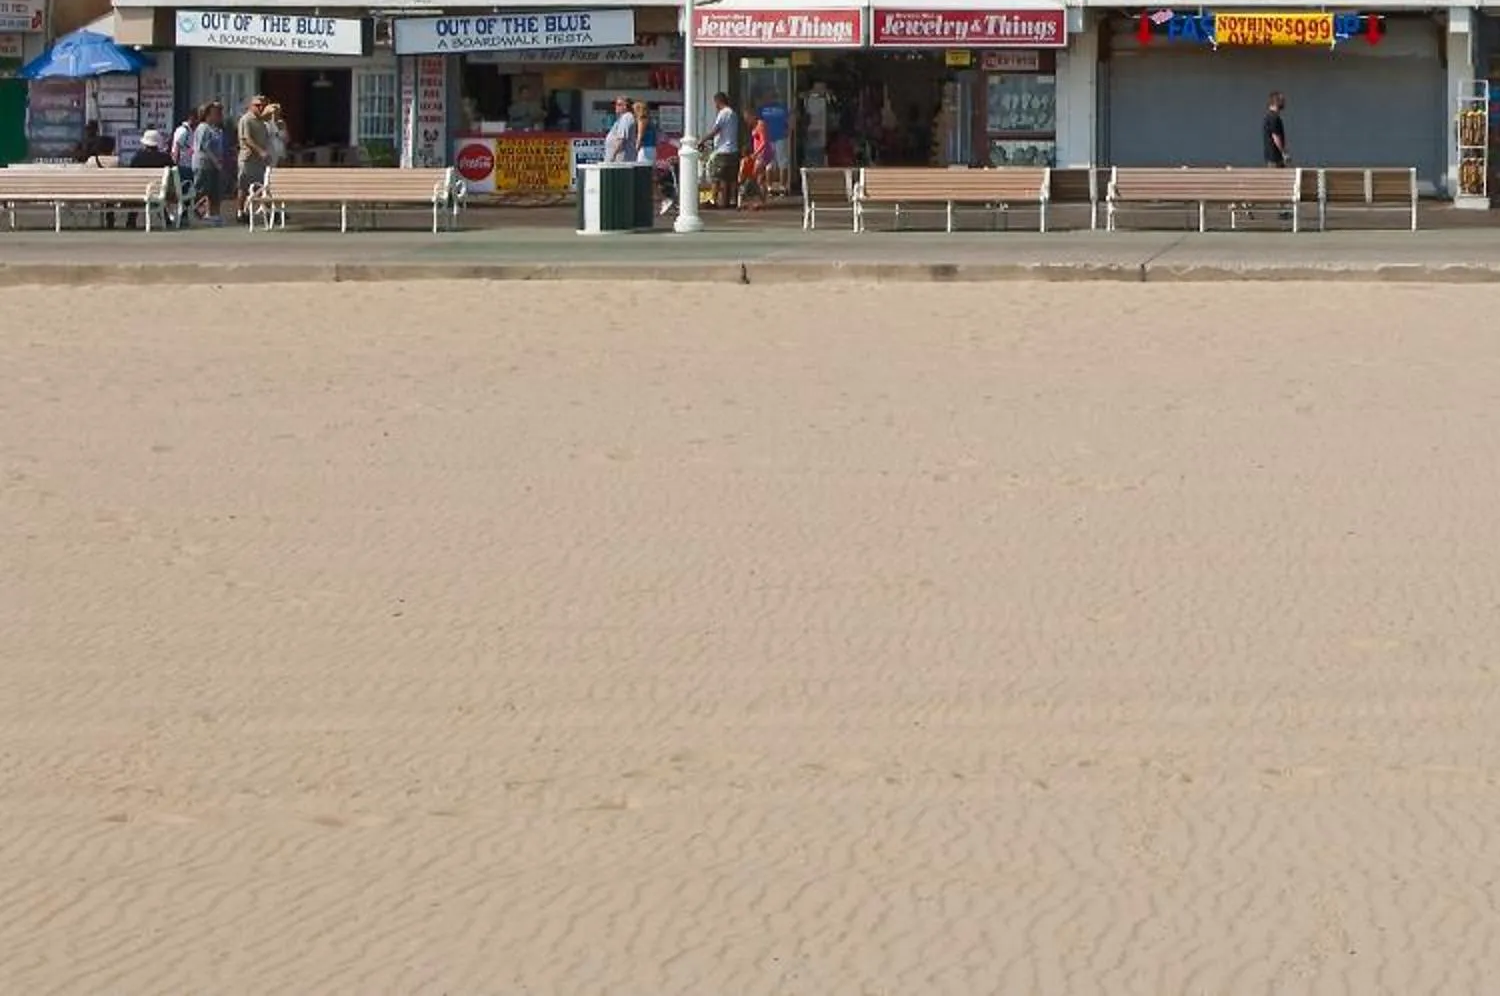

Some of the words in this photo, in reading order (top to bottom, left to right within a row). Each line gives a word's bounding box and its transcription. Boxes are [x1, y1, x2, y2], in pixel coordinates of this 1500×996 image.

[201, 13, 230, 30] OUT
[233, 15, 252, 31] OF
[262, 16, 291, 33] THE
[296, 18, 336, 36] BLUE
[436, 19, 471, 36] OUT
[475, 17, 497, 35] OF
[501, 16, 539, 34] THE
[545, 14, 592, 32] BLUE
[697, 15, 774, 40] Jewelry
[776, 21, 787, 33] &
[788, 14, 853, 42] Things
[881, 14, 970, 40] Jewelry
[971, 19, 982, 33] &
[984, 14, 1057, 42] Things
[1217, 16, 1286, 32] NOTHING
[219, 35, 287, 47] BOARDWALK
[291, 39, 329, 49] FIESTA
[437, 39, 449, 49] A
[451, 35, 540, 49] BOARDWALK
[545, 33, 593, 44] FIESTA
[1228, 32, 1273, 45] OVER
